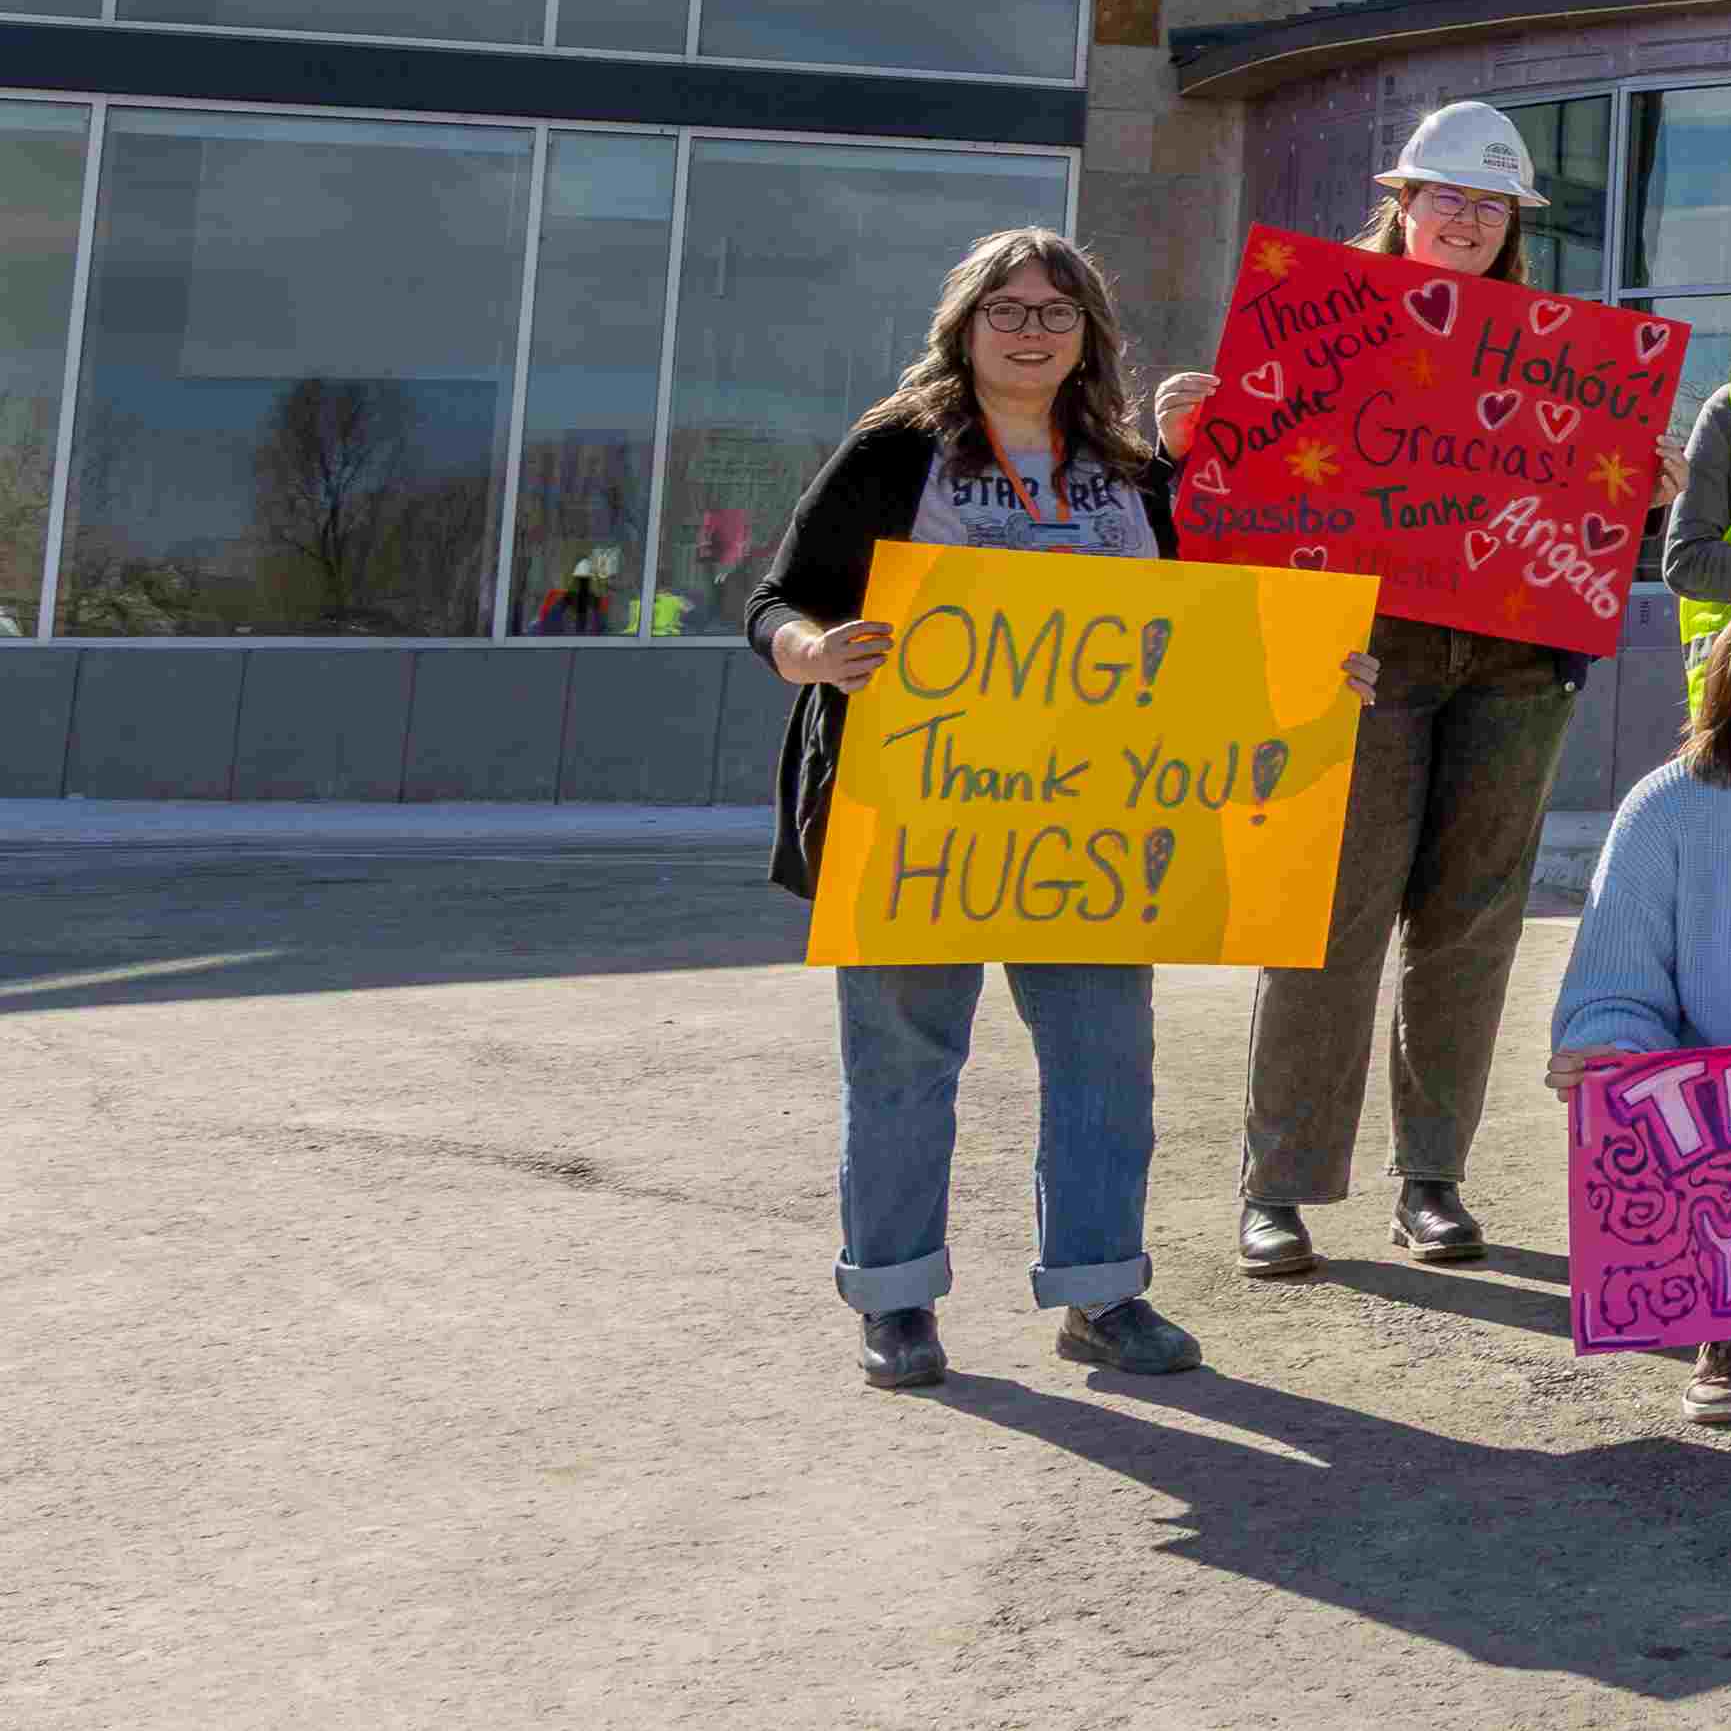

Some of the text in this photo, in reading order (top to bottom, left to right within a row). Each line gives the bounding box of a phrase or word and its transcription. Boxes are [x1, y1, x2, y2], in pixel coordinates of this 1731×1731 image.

[1241, 270, 1389, 350] Thank
[1203, 381, 1342, 468] Danke
[1352, 390, 1577, 488] Gracias!
[1181, 493, 1355, 541] Spasibo
[898, 604, 1174, 707] OMG!
[882, 709, 1093, 803] Thank
[884, 824, 1176, 926] HUGS!
